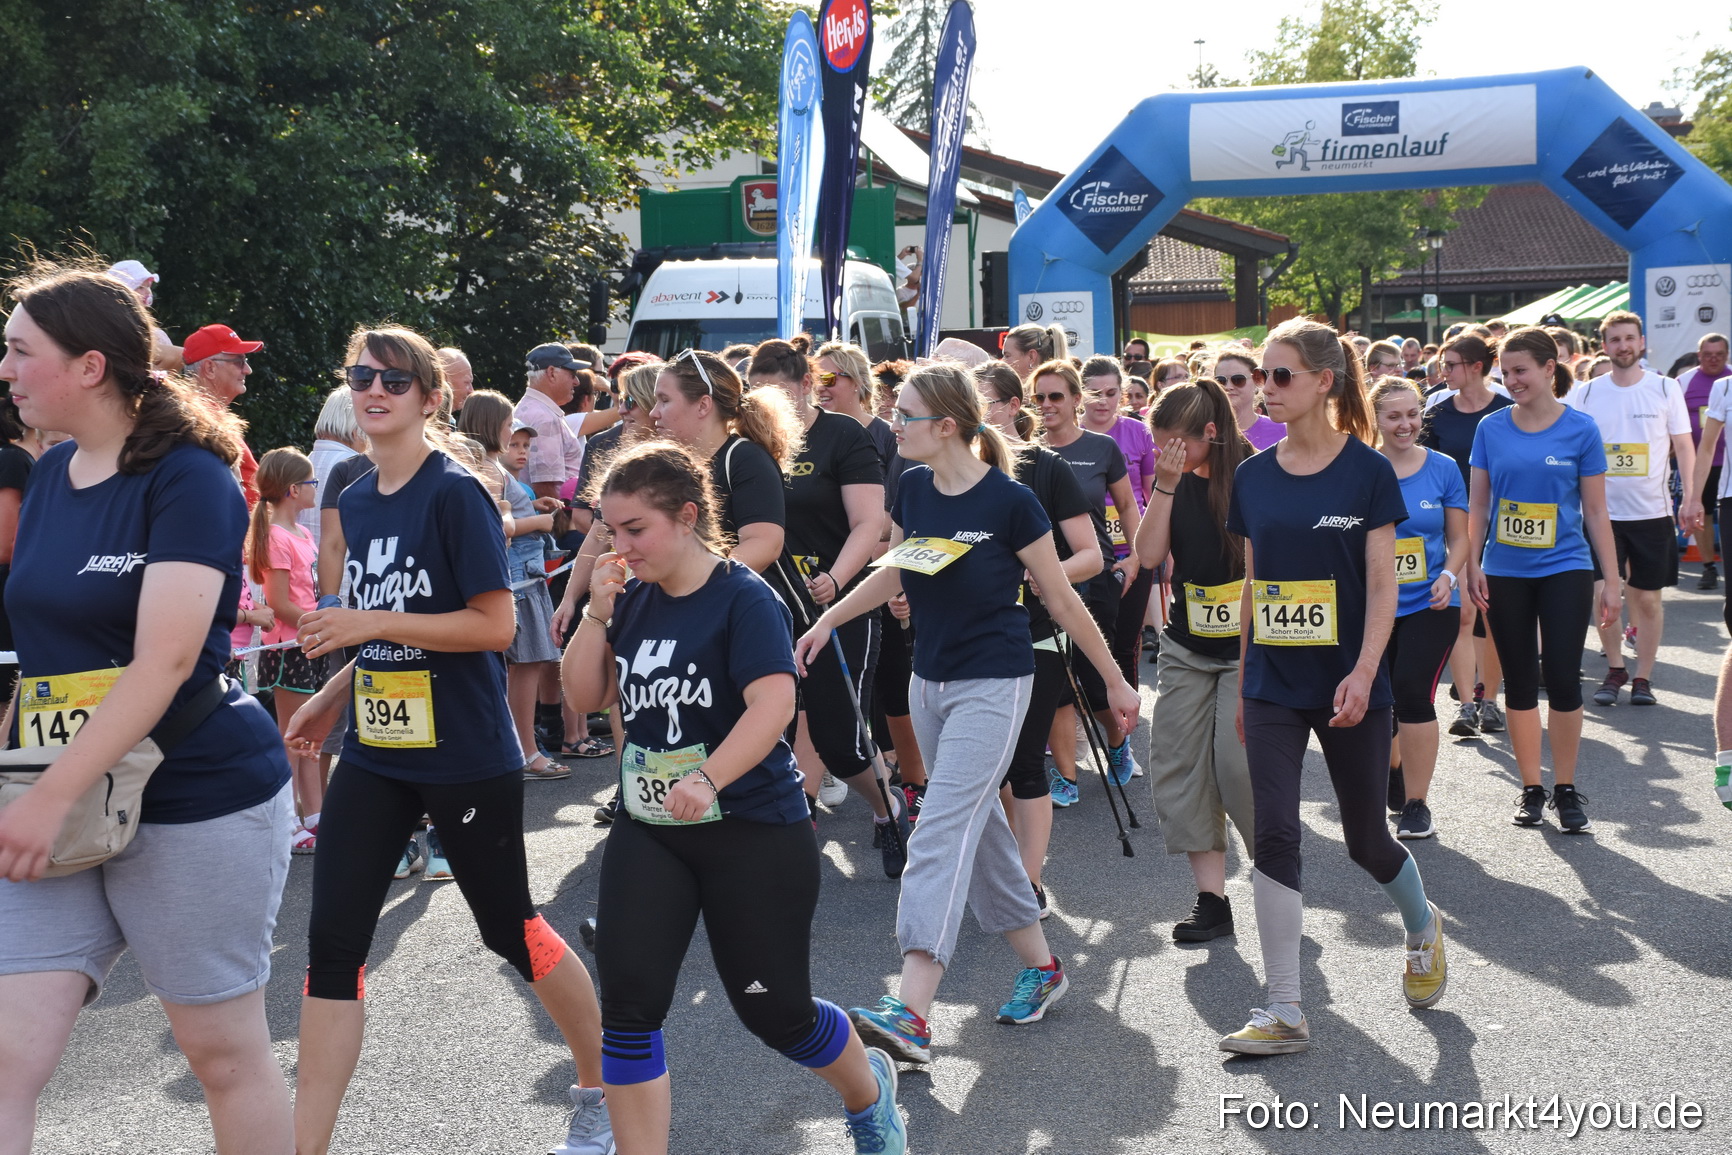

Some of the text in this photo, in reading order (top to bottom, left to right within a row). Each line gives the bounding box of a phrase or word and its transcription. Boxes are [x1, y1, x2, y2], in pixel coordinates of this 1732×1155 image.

[826, 5, 866, 53] Hervis
[952, 44, 968, 142] AUTOMOBILE
[1354, 113, 1397, 125] Fischer
[1321, 131, 1450, 161] firmenlauf
[1321, 160, 1373, 170] neumarkt
[1587, 166, 1608, 178] und
[1608, 163, 1629, 174] das
[1642, 169, 1667, 180] mit!
[1082, 192, 1149, 206] Fischer
[1088, 205, 1143, 214] AUTOMOBILE
[650, 290, 702, 304] abavent
[1616, 455, 1634, 467] 33
[1503, 516, 1545, 536] 1081
[893, 547, 947, 565] 1464
[347, 555, 433, 614] Burgis
[1202, 604, 1231, 623] 76
[1261, 604, 1325, 628] 1446
[614, 655, 713, 745] Burgis
[365, 697, 411, 727] 394
[366, 725, 414, 735] Paulus Cornelia
